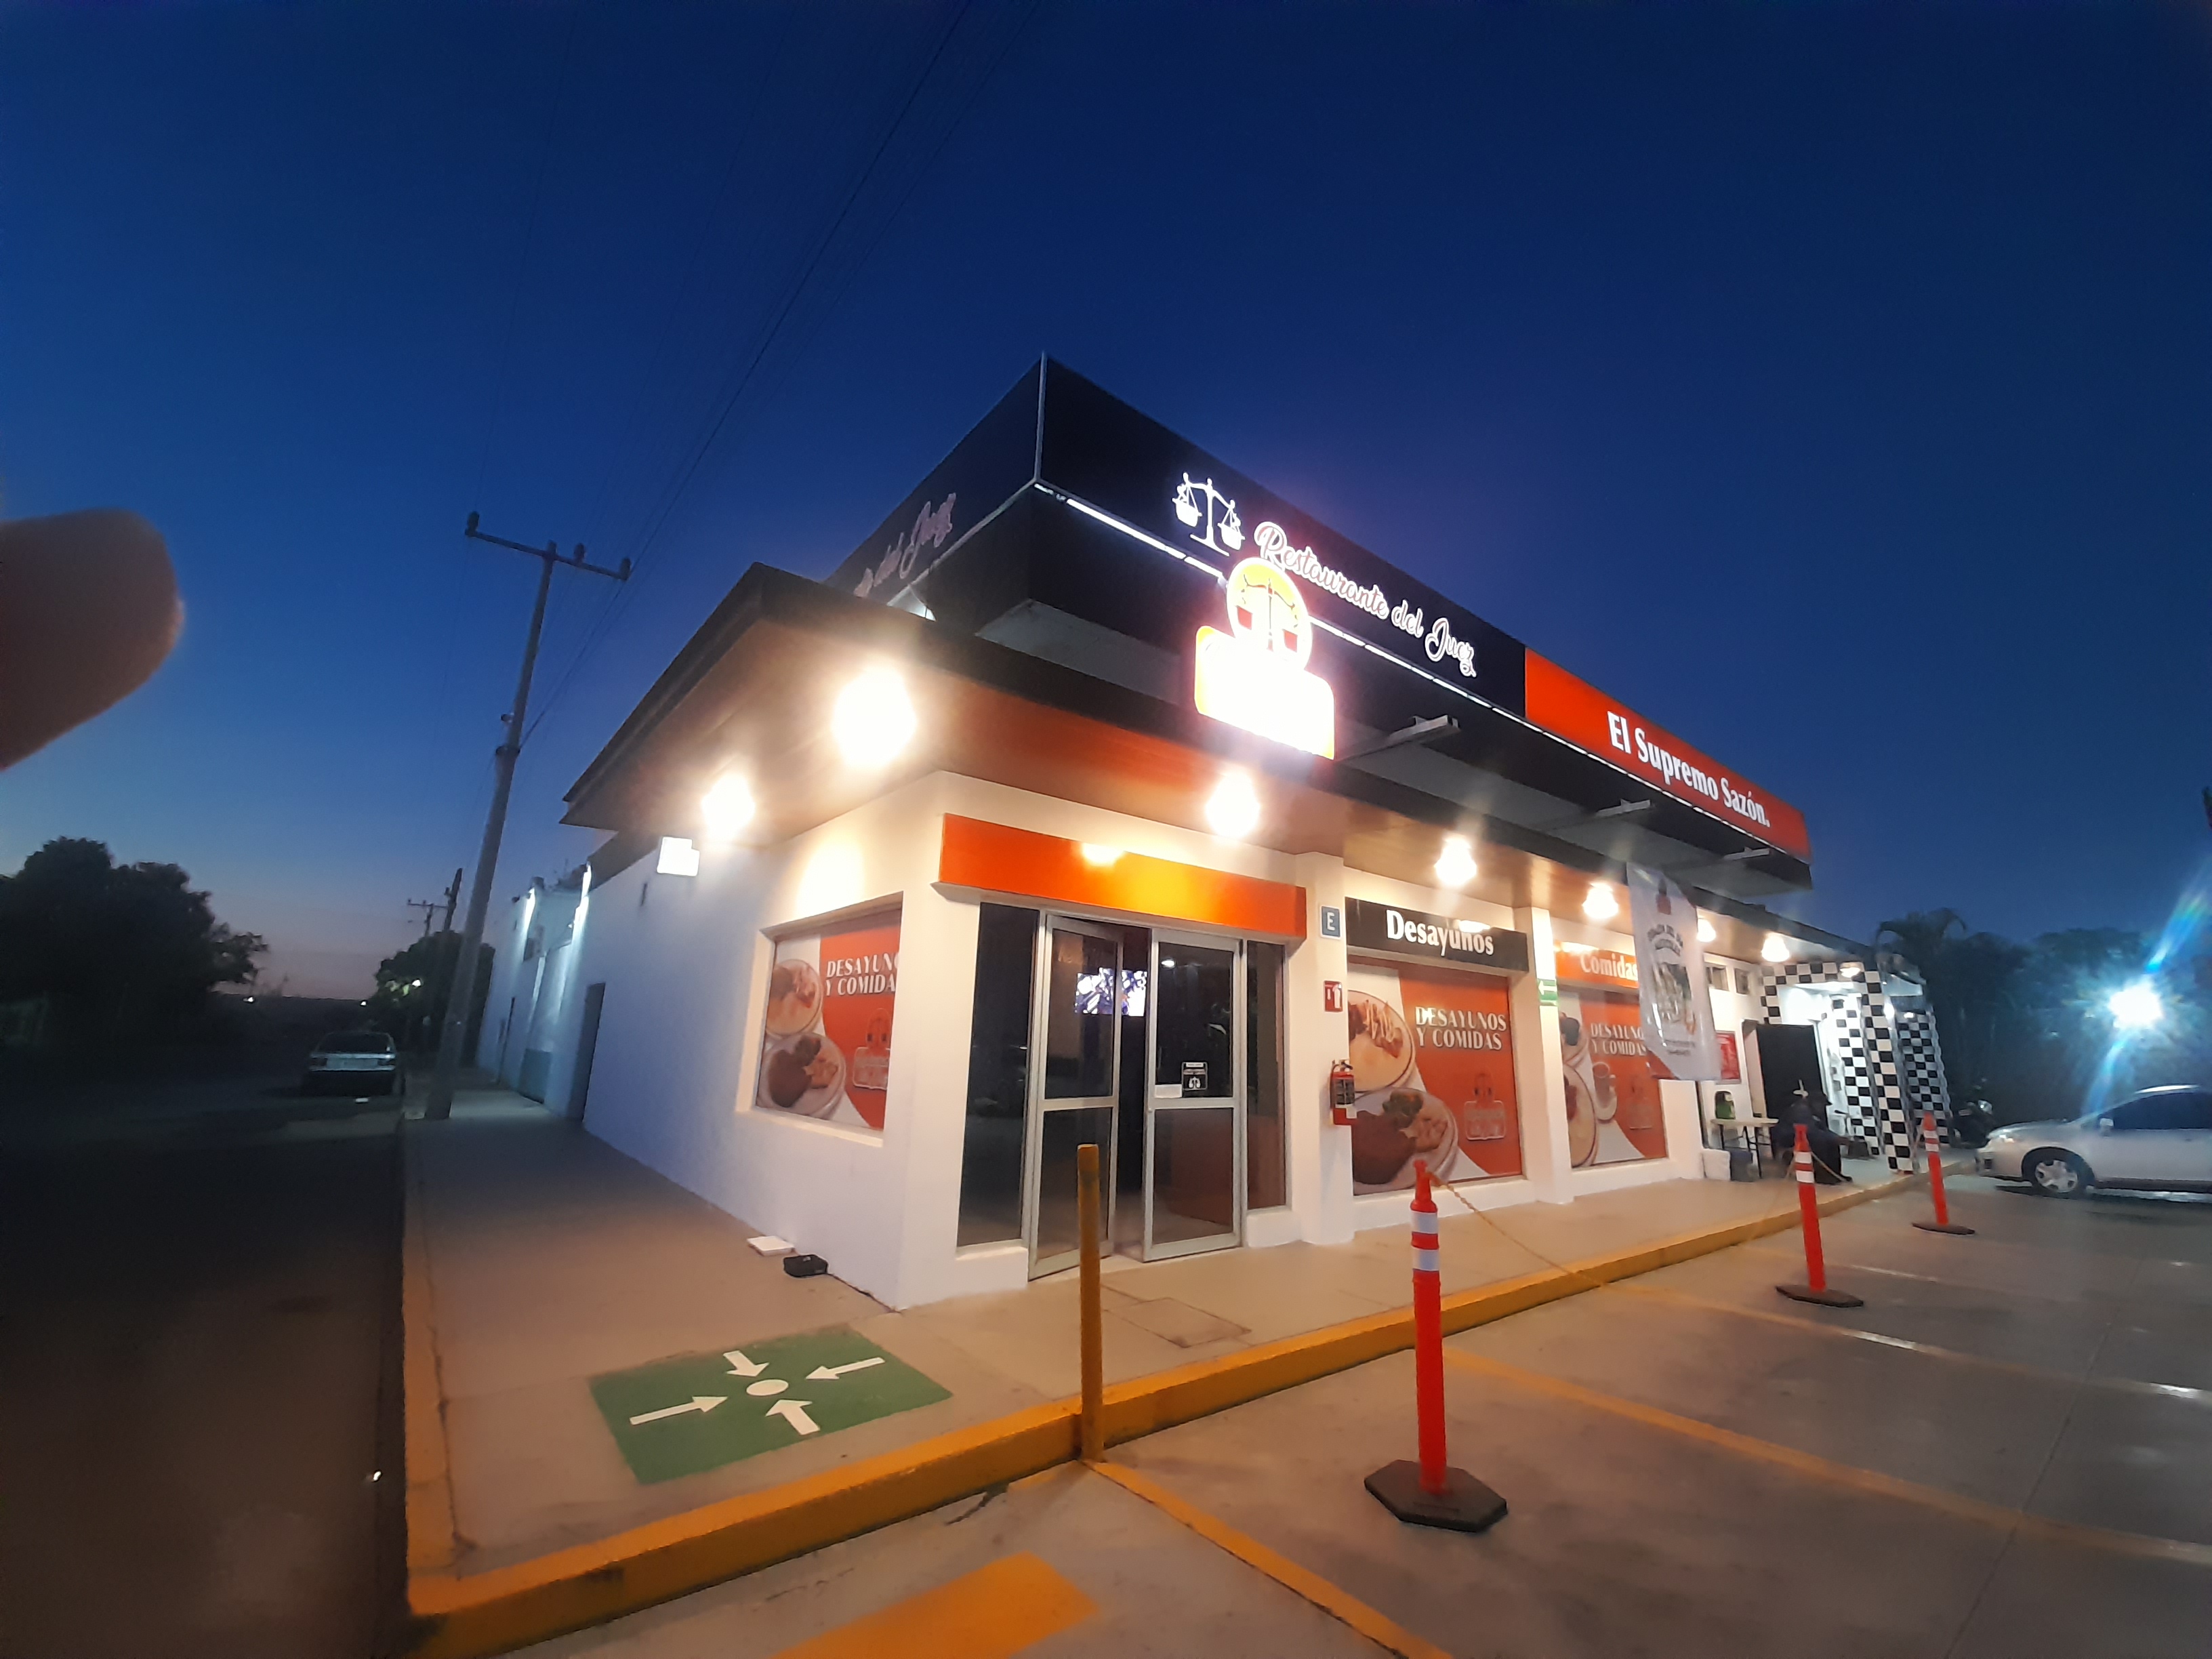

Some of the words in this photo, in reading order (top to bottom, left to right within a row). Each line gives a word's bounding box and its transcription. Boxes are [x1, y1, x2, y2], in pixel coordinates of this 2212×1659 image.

[1254, 521, 1390, 620] Restaurante
[1391, 599, 1425, 638] del
[1425, 617, 1477, 678] Juez
[1607, 710, 1632, 754] El
[1635, 728, 1719, 800] Supremo
[1721, 777, 1771, 827] Sazón.
[1326, 912, 1336, 931] E
[1386, 909, 1494, 956] Desayunos
[826, 953, 899, 978] DESAYUN
[825, 979, 832, 996] Y
[837, 973, 896, 996] COMIDA
[1415, 1006, 1507, 1031] DESAYUNOS
[1416, 1027, 1426, 1047] Y
[1432, 1029, 1502, 1050] COMIDAS
[1591, 1022, 1645, 1040] DESAYUNO
[1591, 1038, 1599, 1054] Y
